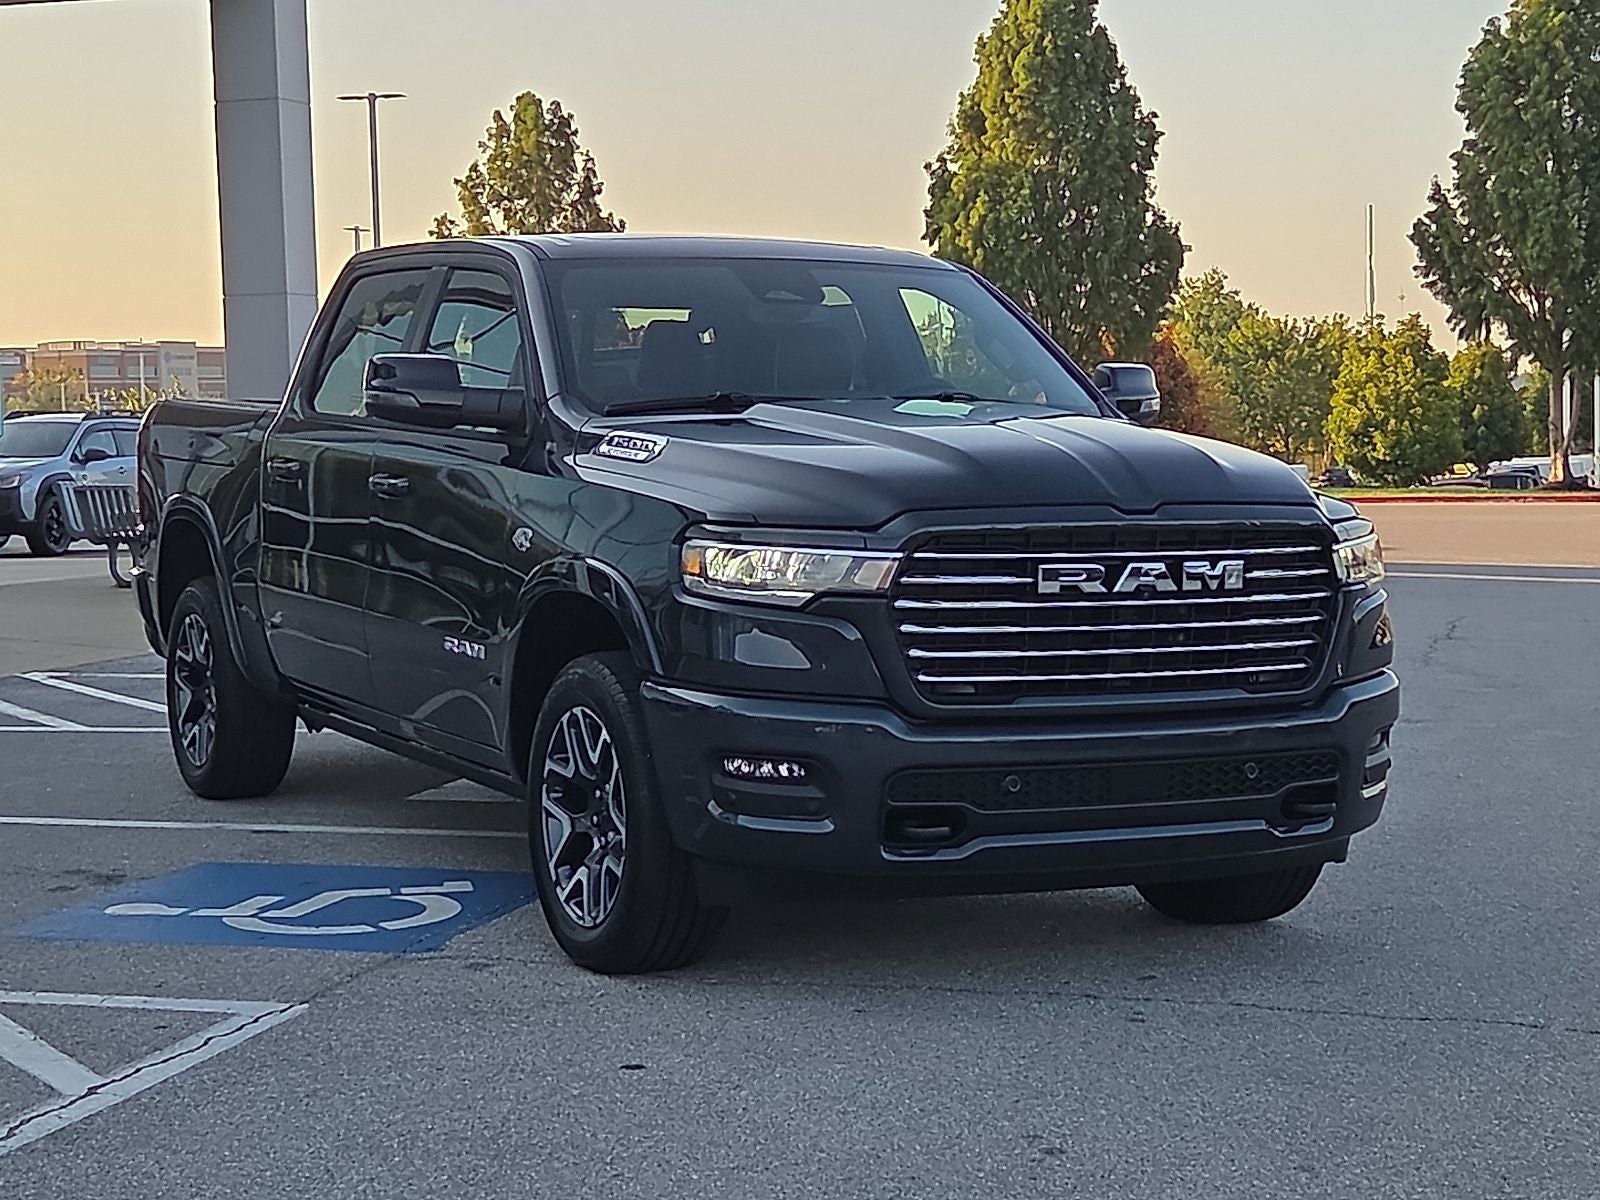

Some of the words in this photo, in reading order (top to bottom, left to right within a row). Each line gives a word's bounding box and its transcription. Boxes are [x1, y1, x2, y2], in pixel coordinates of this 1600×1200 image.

[612, 436, 655, 452] 1500
[1038, 560, 1245, 594] RAM
[444, 637, 486, 660] RAM
